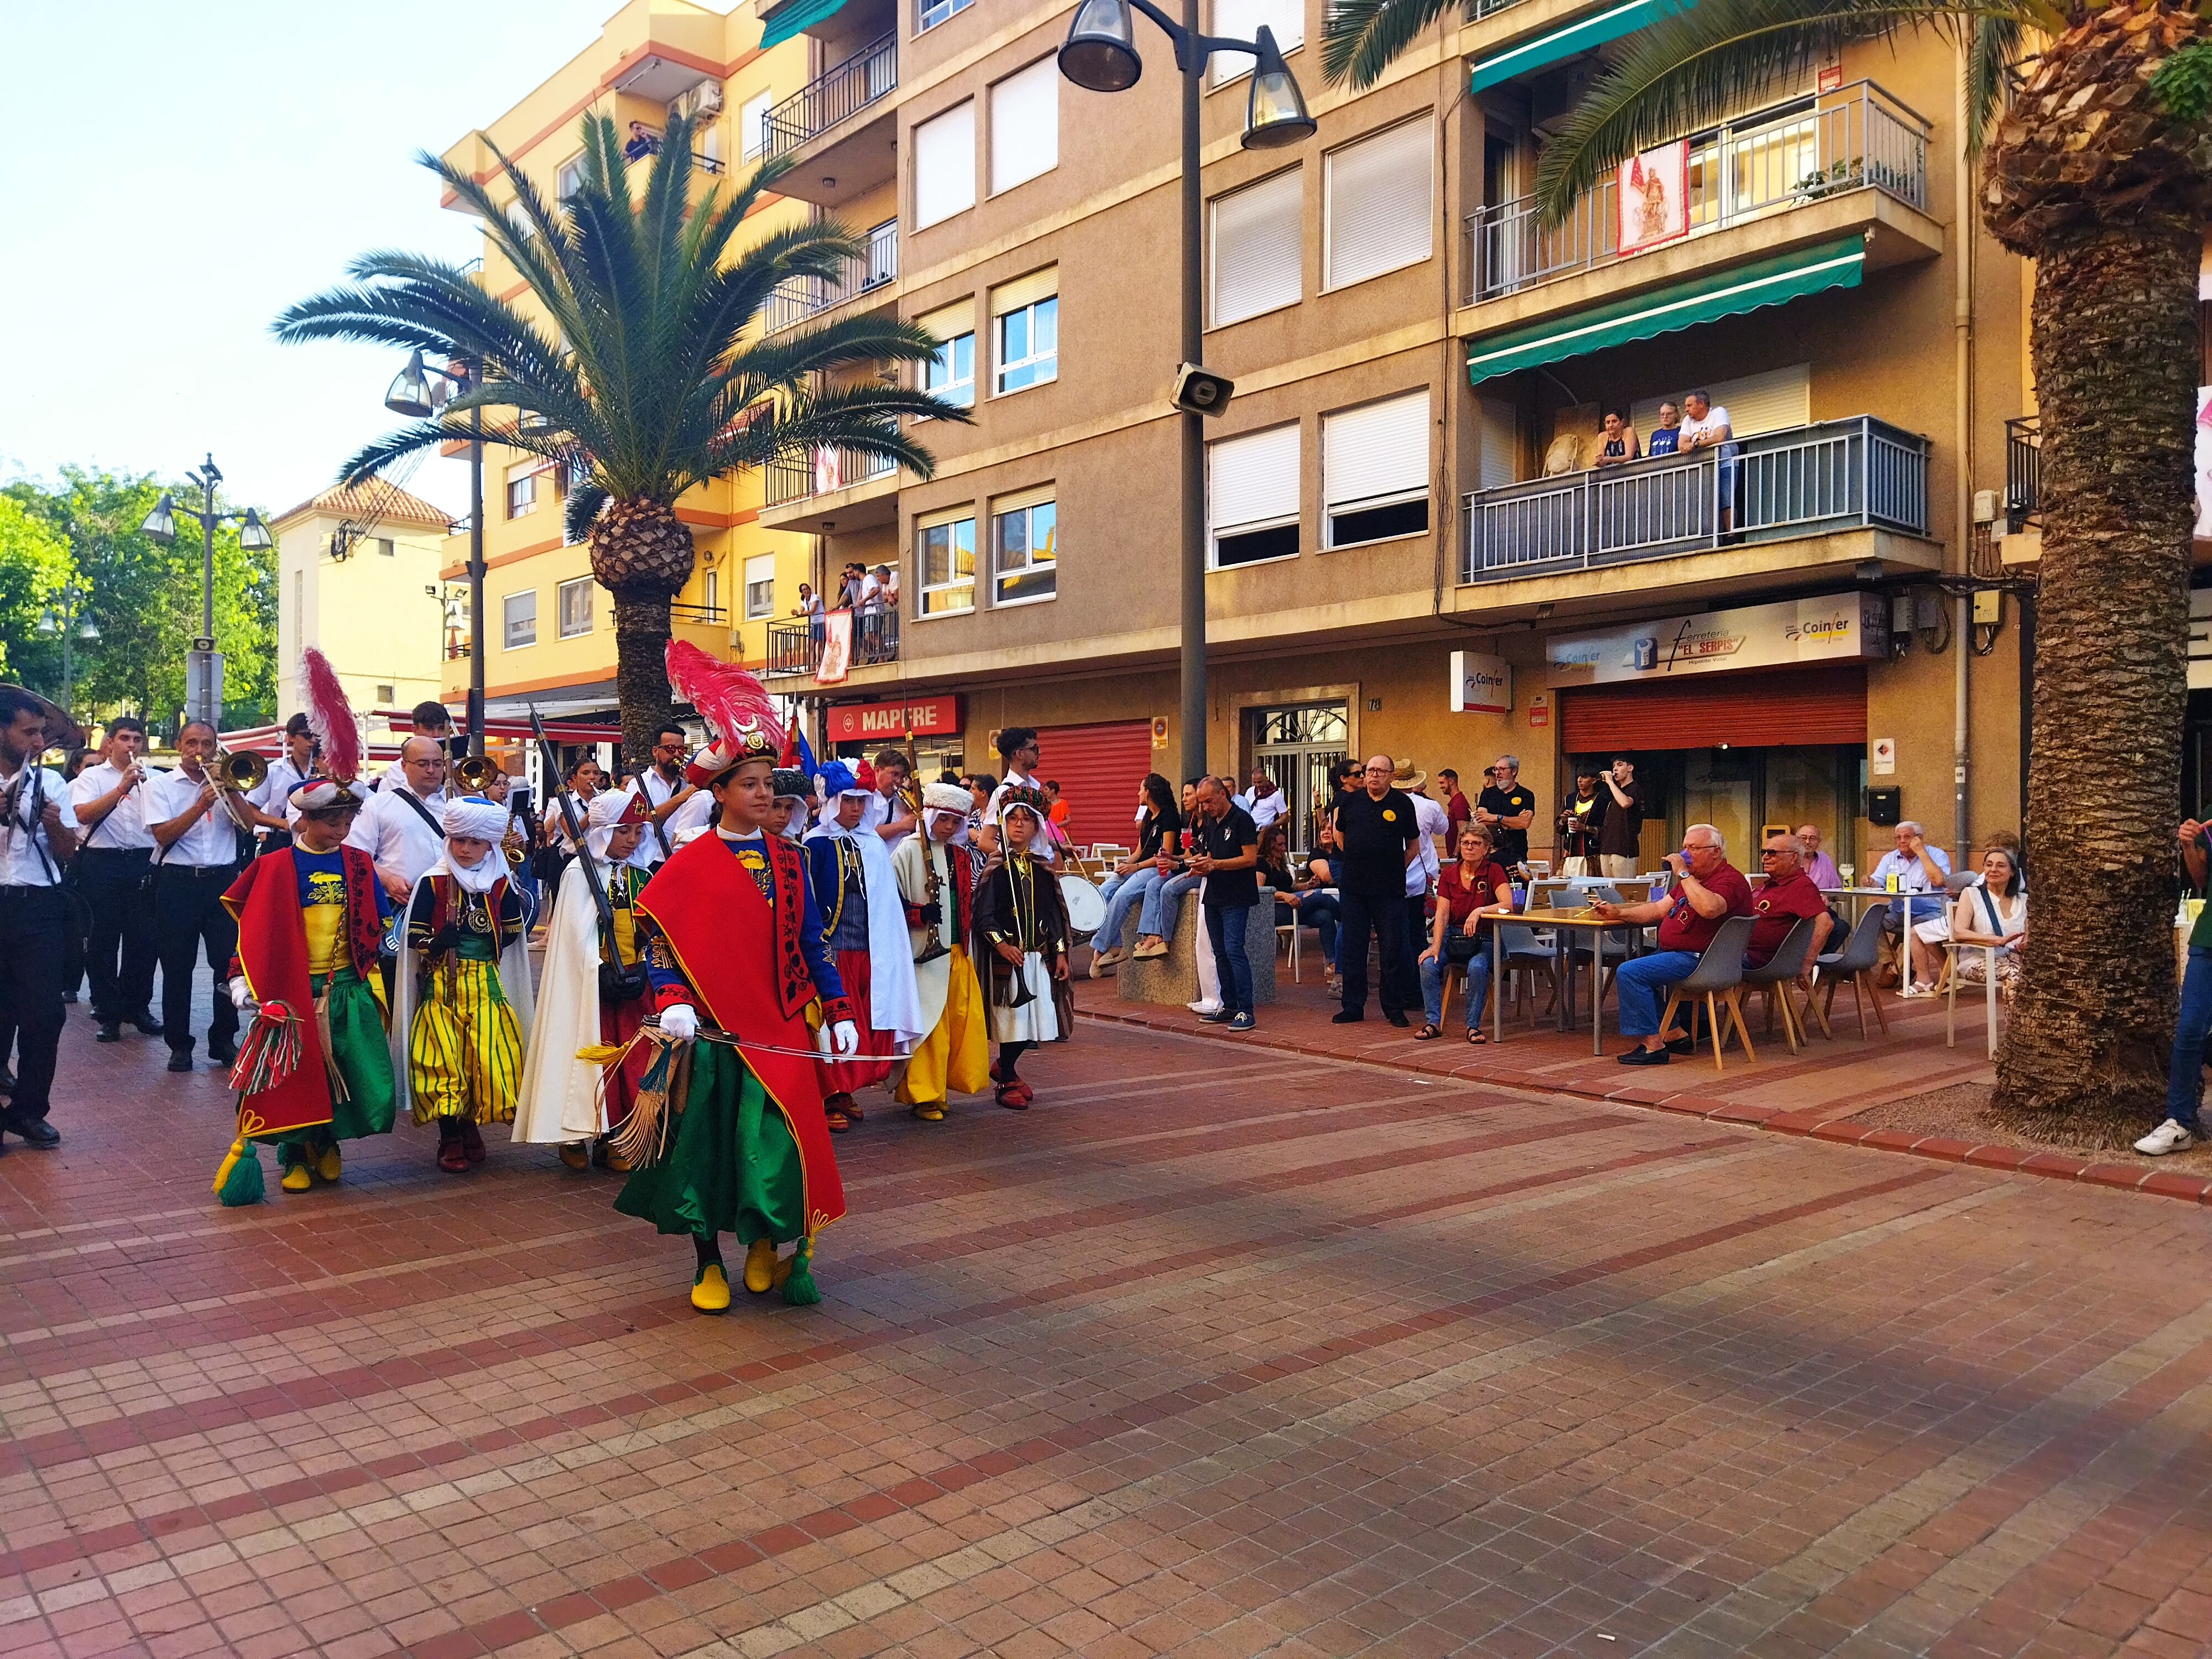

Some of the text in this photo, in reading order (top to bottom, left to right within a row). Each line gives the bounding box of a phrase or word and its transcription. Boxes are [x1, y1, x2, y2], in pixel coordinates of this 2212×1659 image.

[1803, 612, 1849, 644] Coinfer
[1476, 669, 1503, 697] Coinfer
[862, 705, 937, 731] MAPFRE
